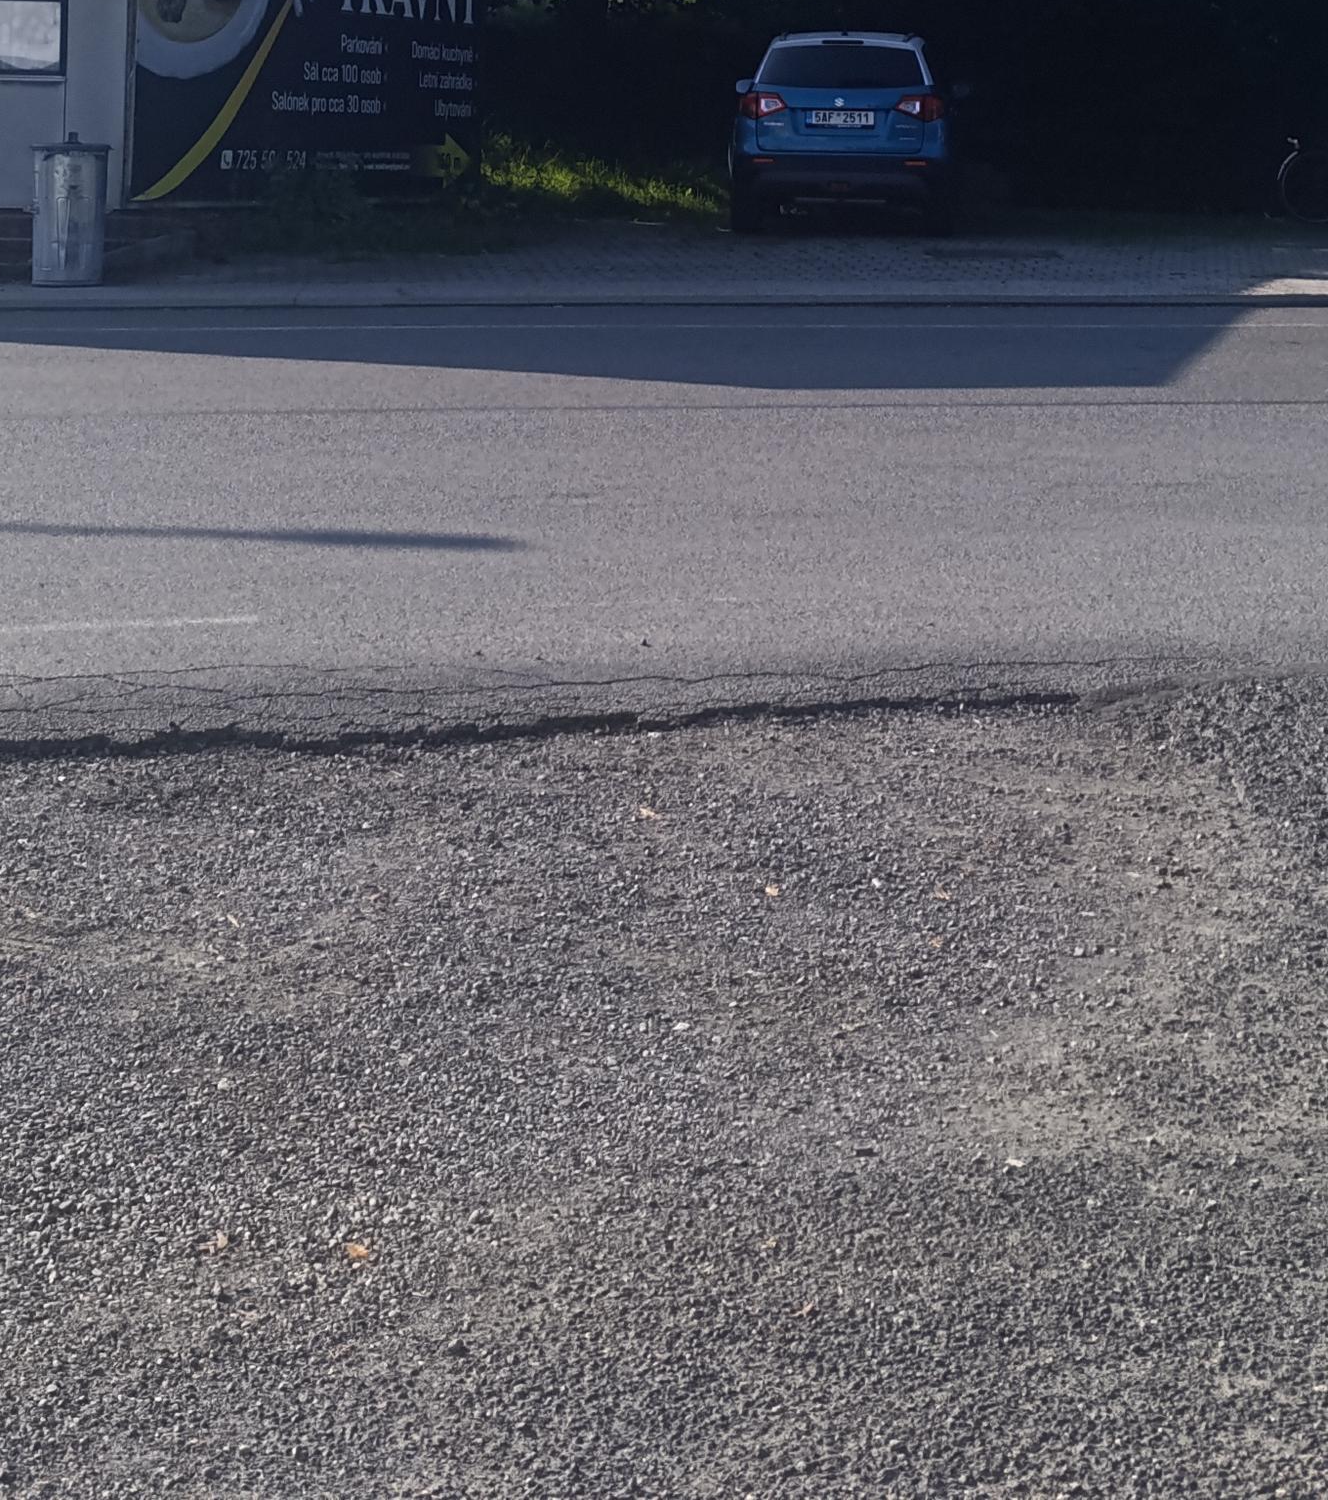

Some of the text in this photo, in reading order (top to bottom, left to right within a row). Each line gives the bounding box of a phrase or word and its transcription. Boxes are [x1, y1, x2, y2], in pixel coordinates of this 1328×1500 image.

[340, 34, 383, 55] Parkování
[303, 61, 382, 85] Sál cca 100 osob
[272, 91, 381, 115] Salónek pro cca 30 osob
[236, 149, 257, 170] 725
